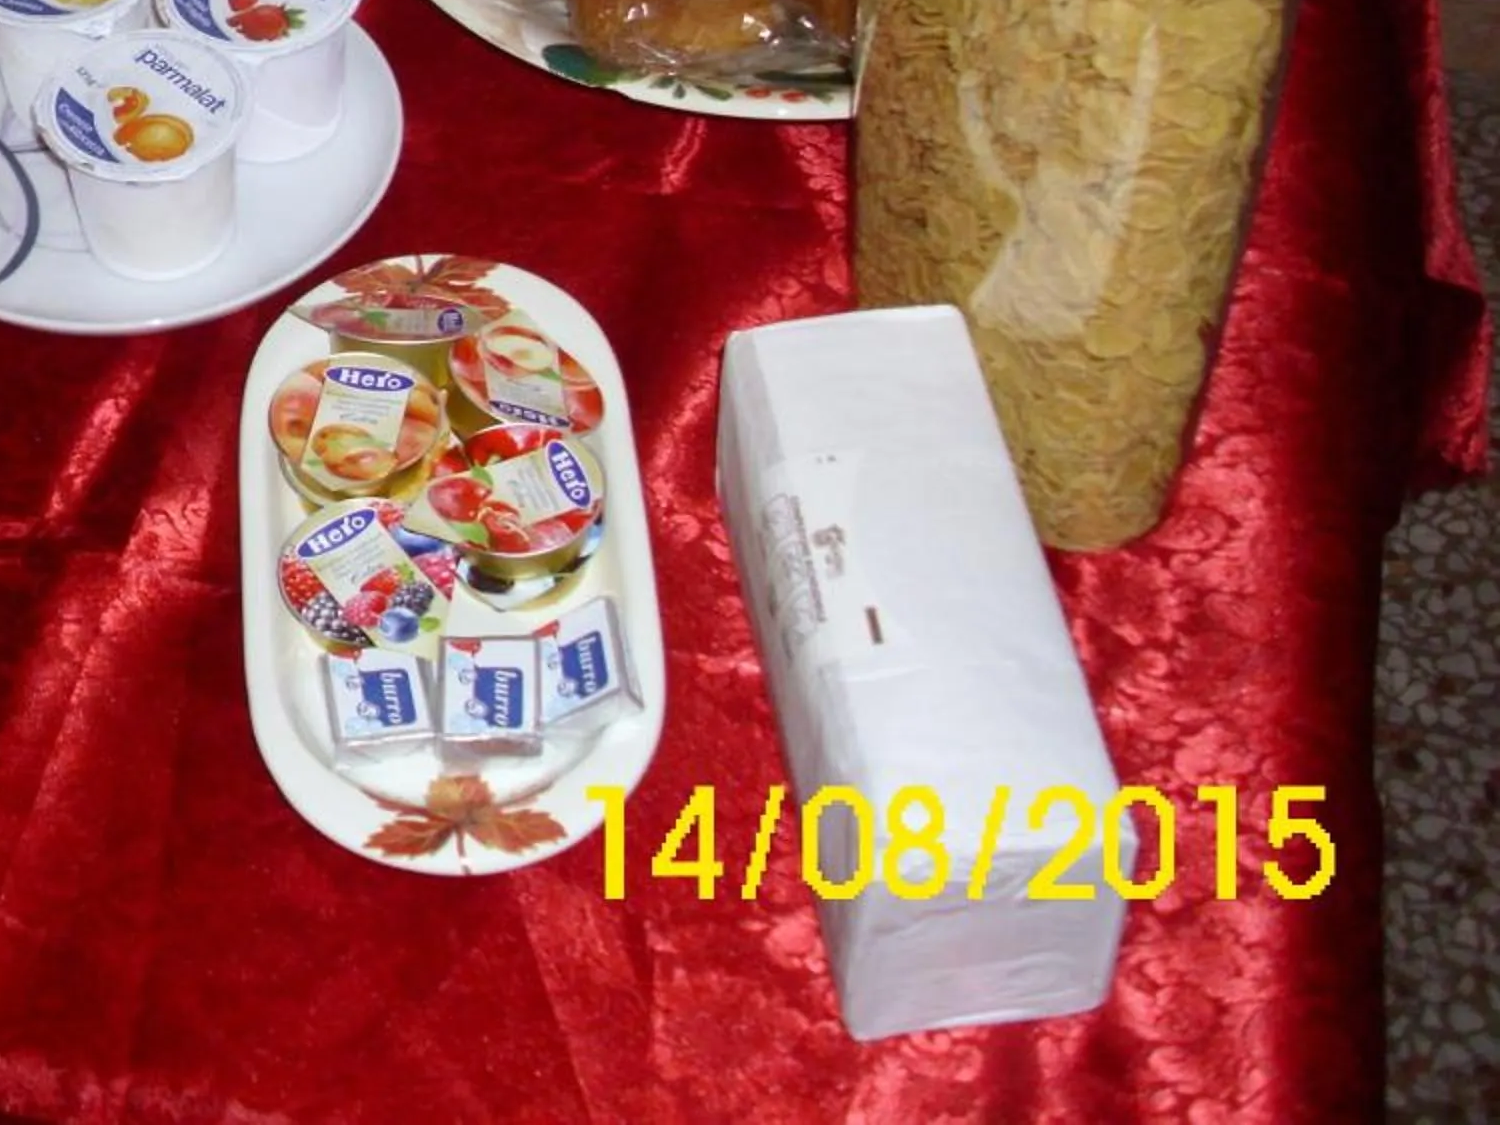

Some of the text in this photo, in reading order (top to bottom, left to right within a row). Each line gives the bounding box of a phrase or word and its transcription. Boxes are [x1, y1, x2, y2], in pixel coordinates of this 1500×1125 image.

[134, 48, 227, 115] parmalat
[337, 368, 403, 390] Hero
[551, 449, 585, 502] Hero
[305, 512, 367, 555] Hero
[578, 637, 598, 693] burro
[380, 672, 403, 725] burro
[494, 670, 517, 726] burro
